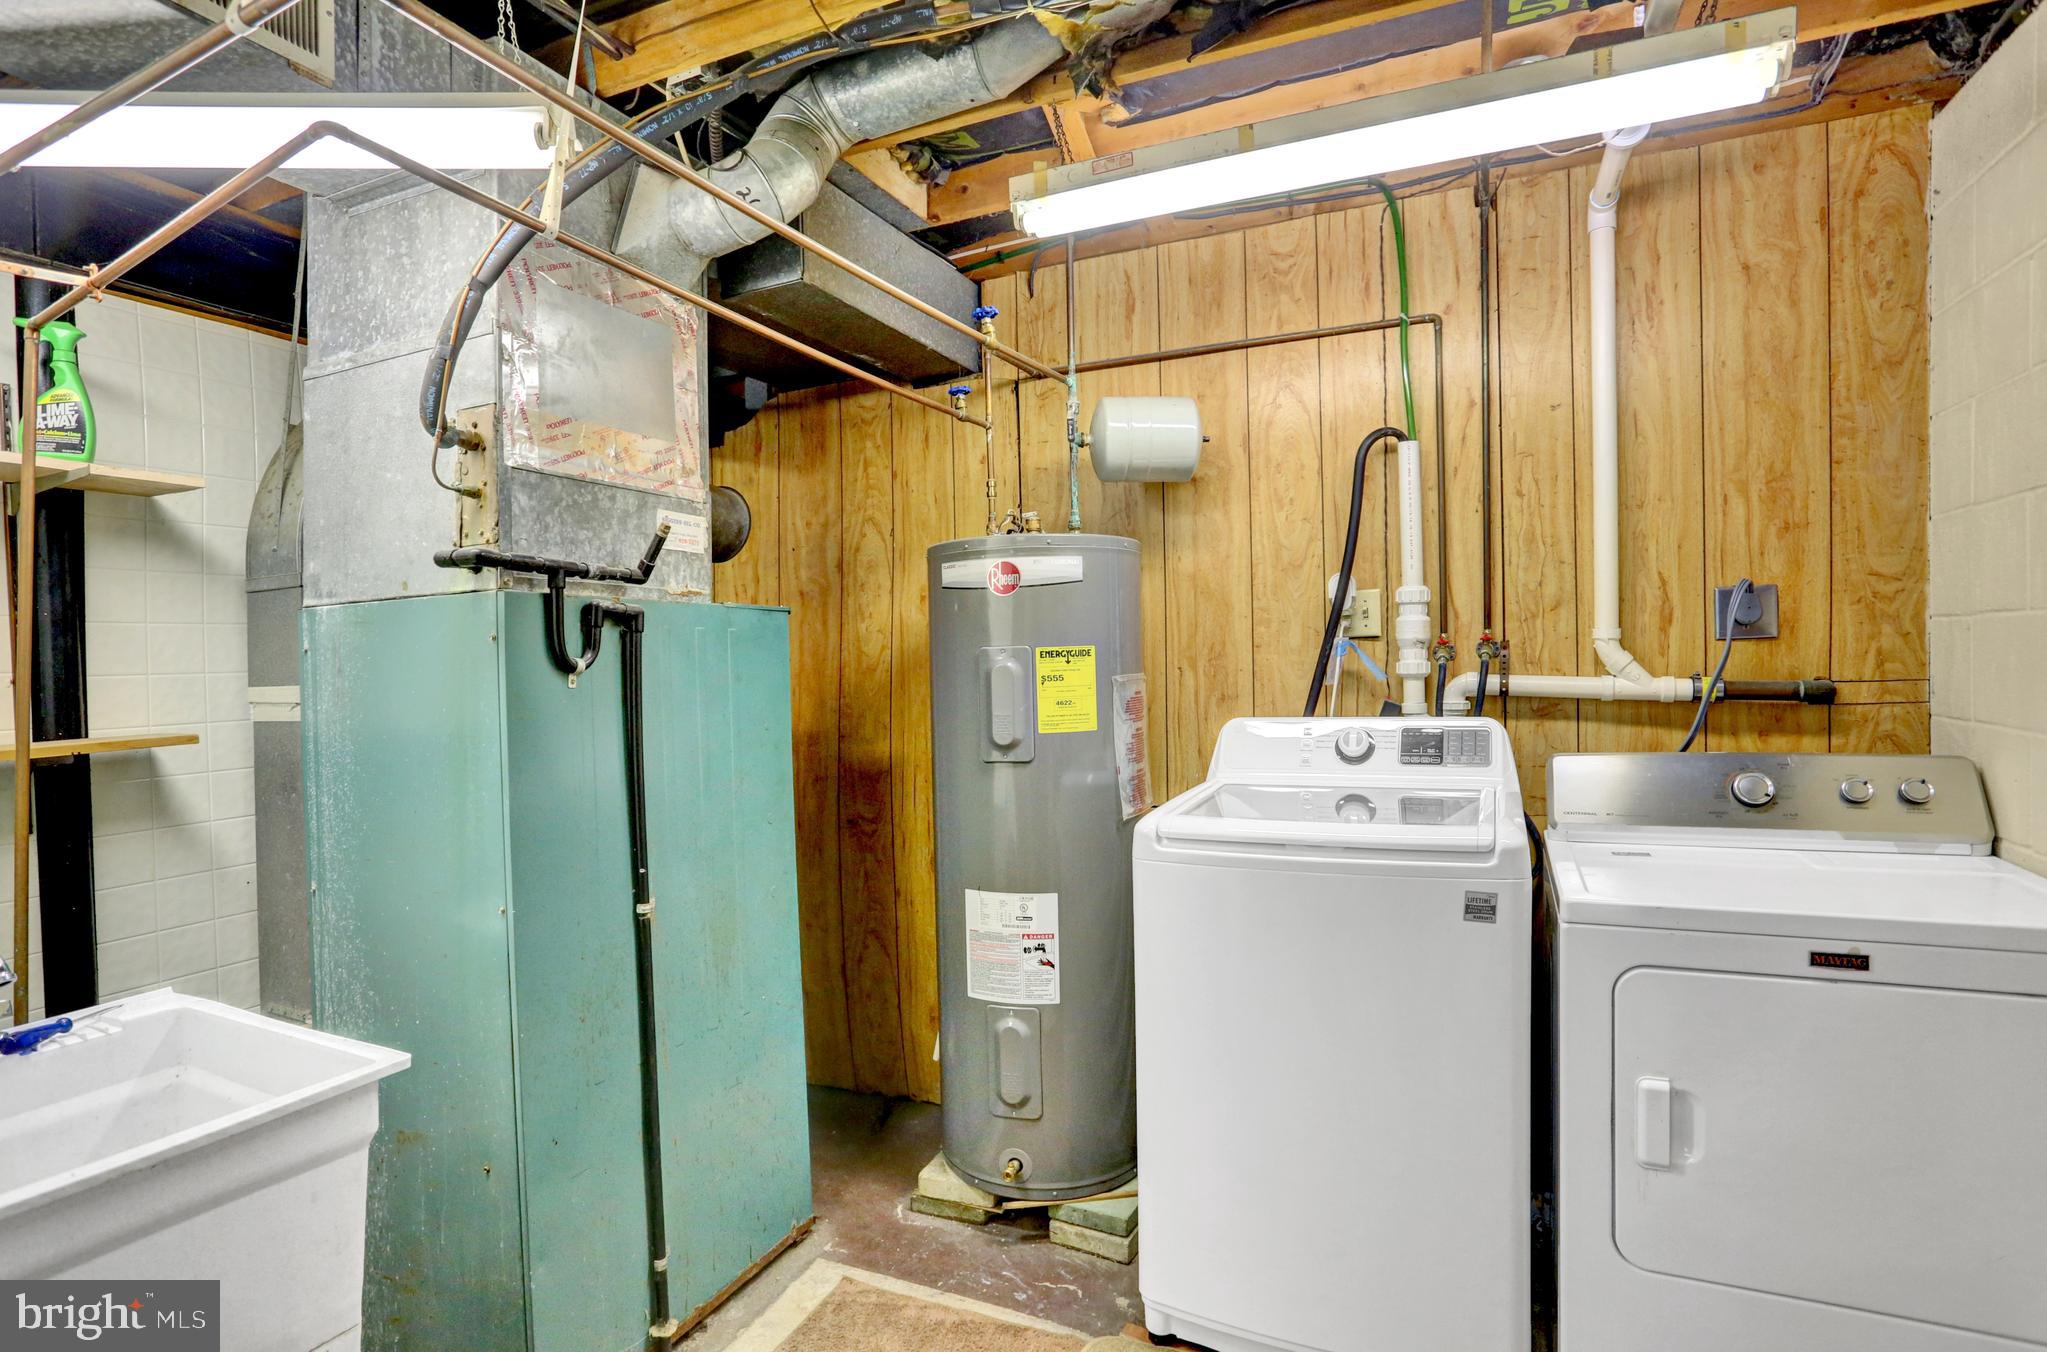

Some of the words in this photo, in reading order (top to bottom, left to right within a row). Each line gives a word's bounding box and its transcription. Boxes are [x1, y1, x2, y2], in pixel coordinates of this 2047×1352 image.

[991, 561, 1020, 591] Rheem
[1041, 674, 1065, 683] $555
[1467, 896, 1491, 904] LIFETIME
[1813, 955, 1866, 967] MAYTAG
